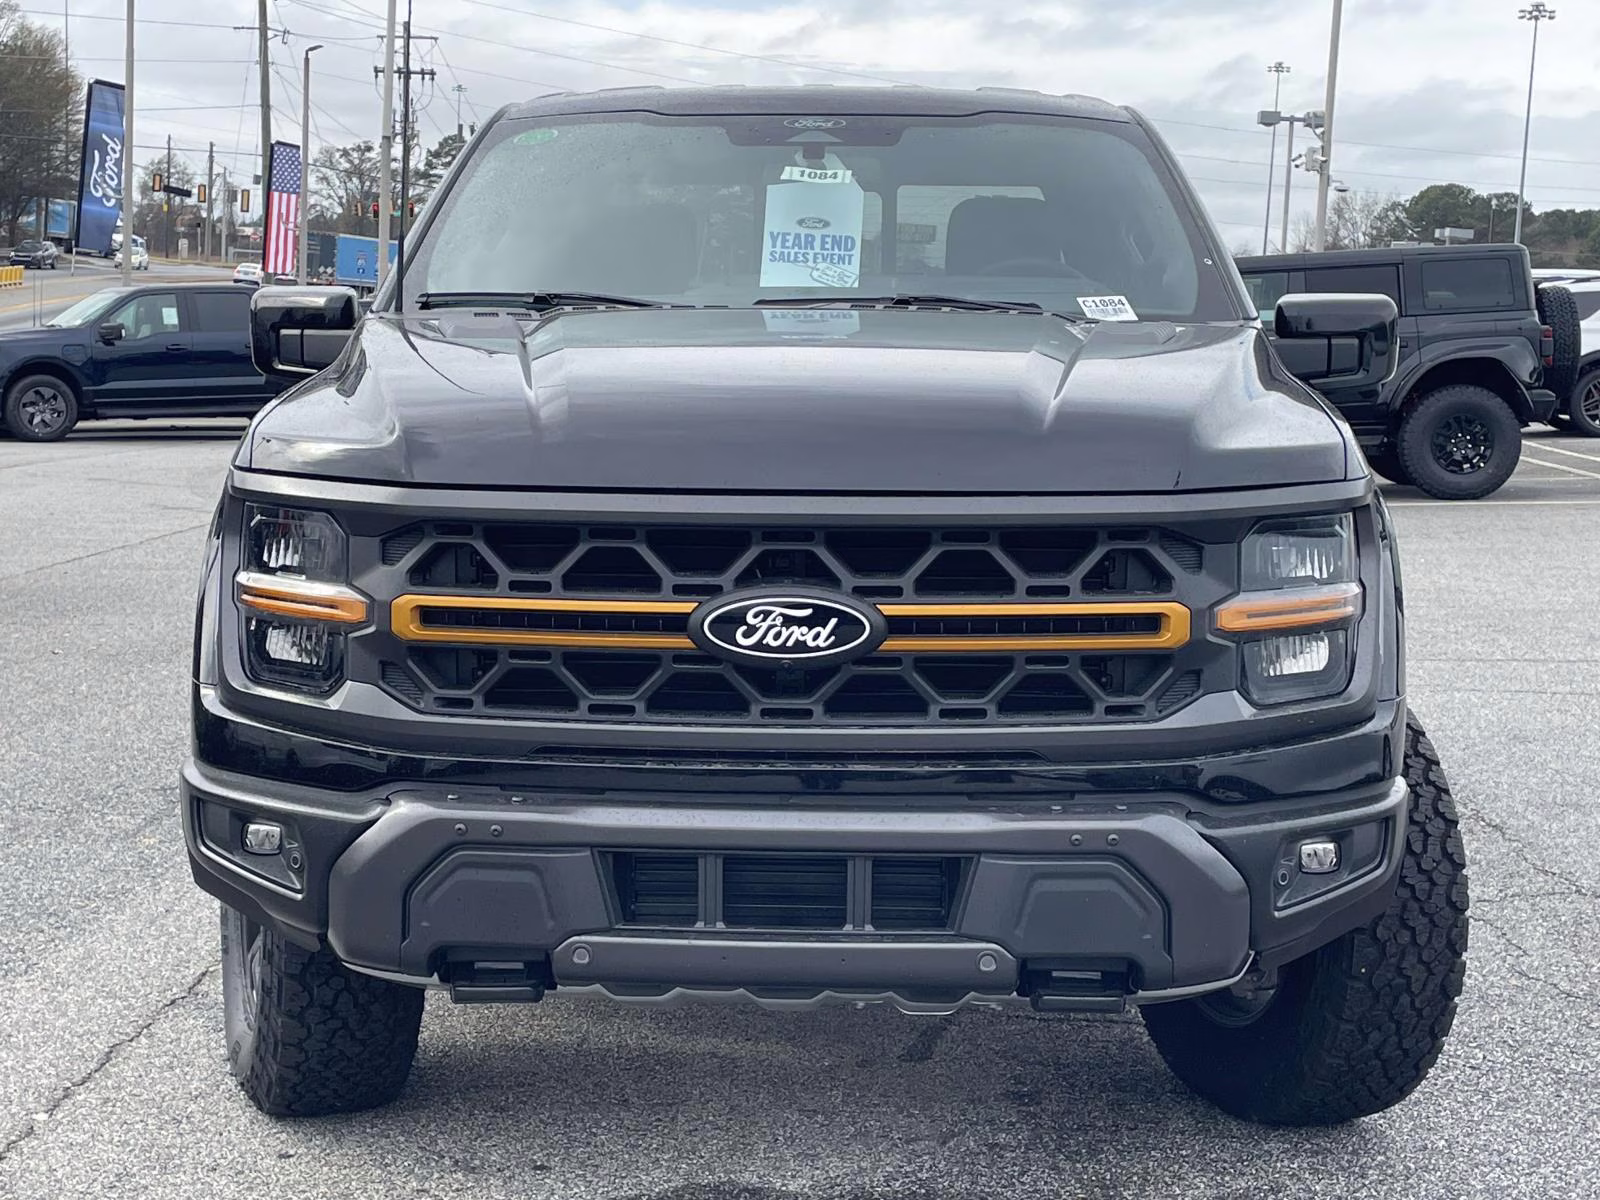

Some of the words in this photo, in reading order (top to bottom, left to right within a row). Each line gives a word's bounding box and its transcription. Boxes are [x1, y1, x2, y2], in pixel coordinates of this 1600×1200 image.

[90, 133, 121, 207] Ford
[799, 169, 838, 180] 1084
[802, 218, 825, 229] Ford
[769, 231, 816, 251] YEAR
[820, 234, 856, 252] END
[769, 250, 810, 264] SALES
[812, 252, 854, 266] EVENT
[1082, 298, 1125, 308] C1084
[735, 605, 838, 648] Ford
